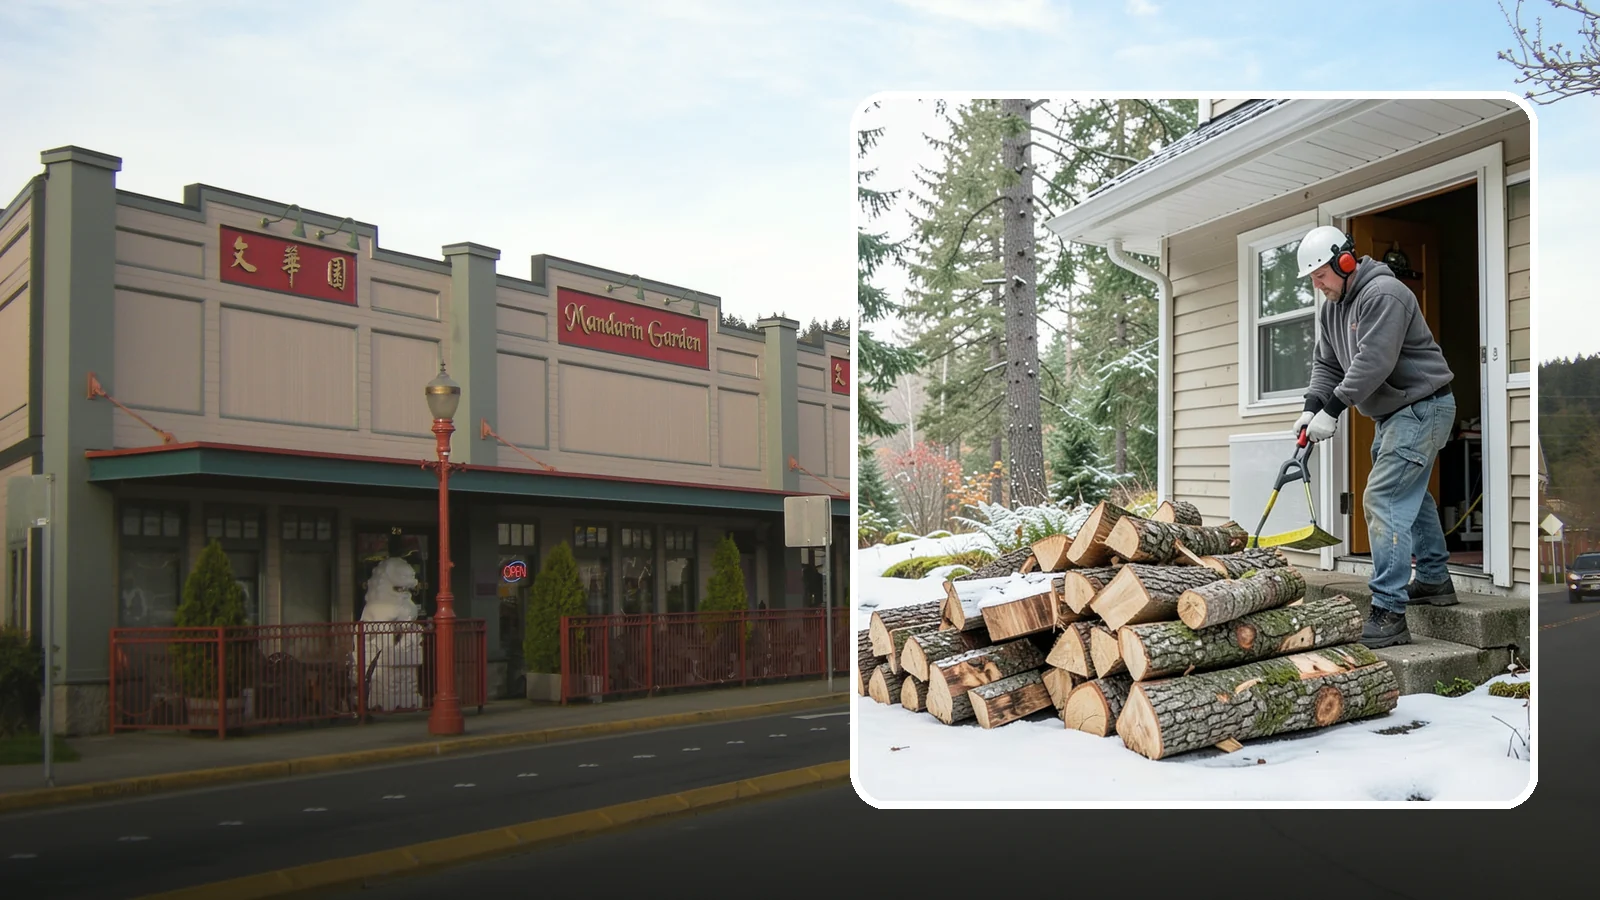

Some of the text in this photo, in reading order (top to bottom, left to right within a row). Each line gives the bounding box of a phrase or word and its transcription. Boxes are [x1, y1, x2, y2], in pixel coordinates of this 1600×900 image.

[231, 236, 346, 291] 文華園
[564, 302, 701, 352] Mandarin Garden
[503, 565, 527, 578] OPEN
